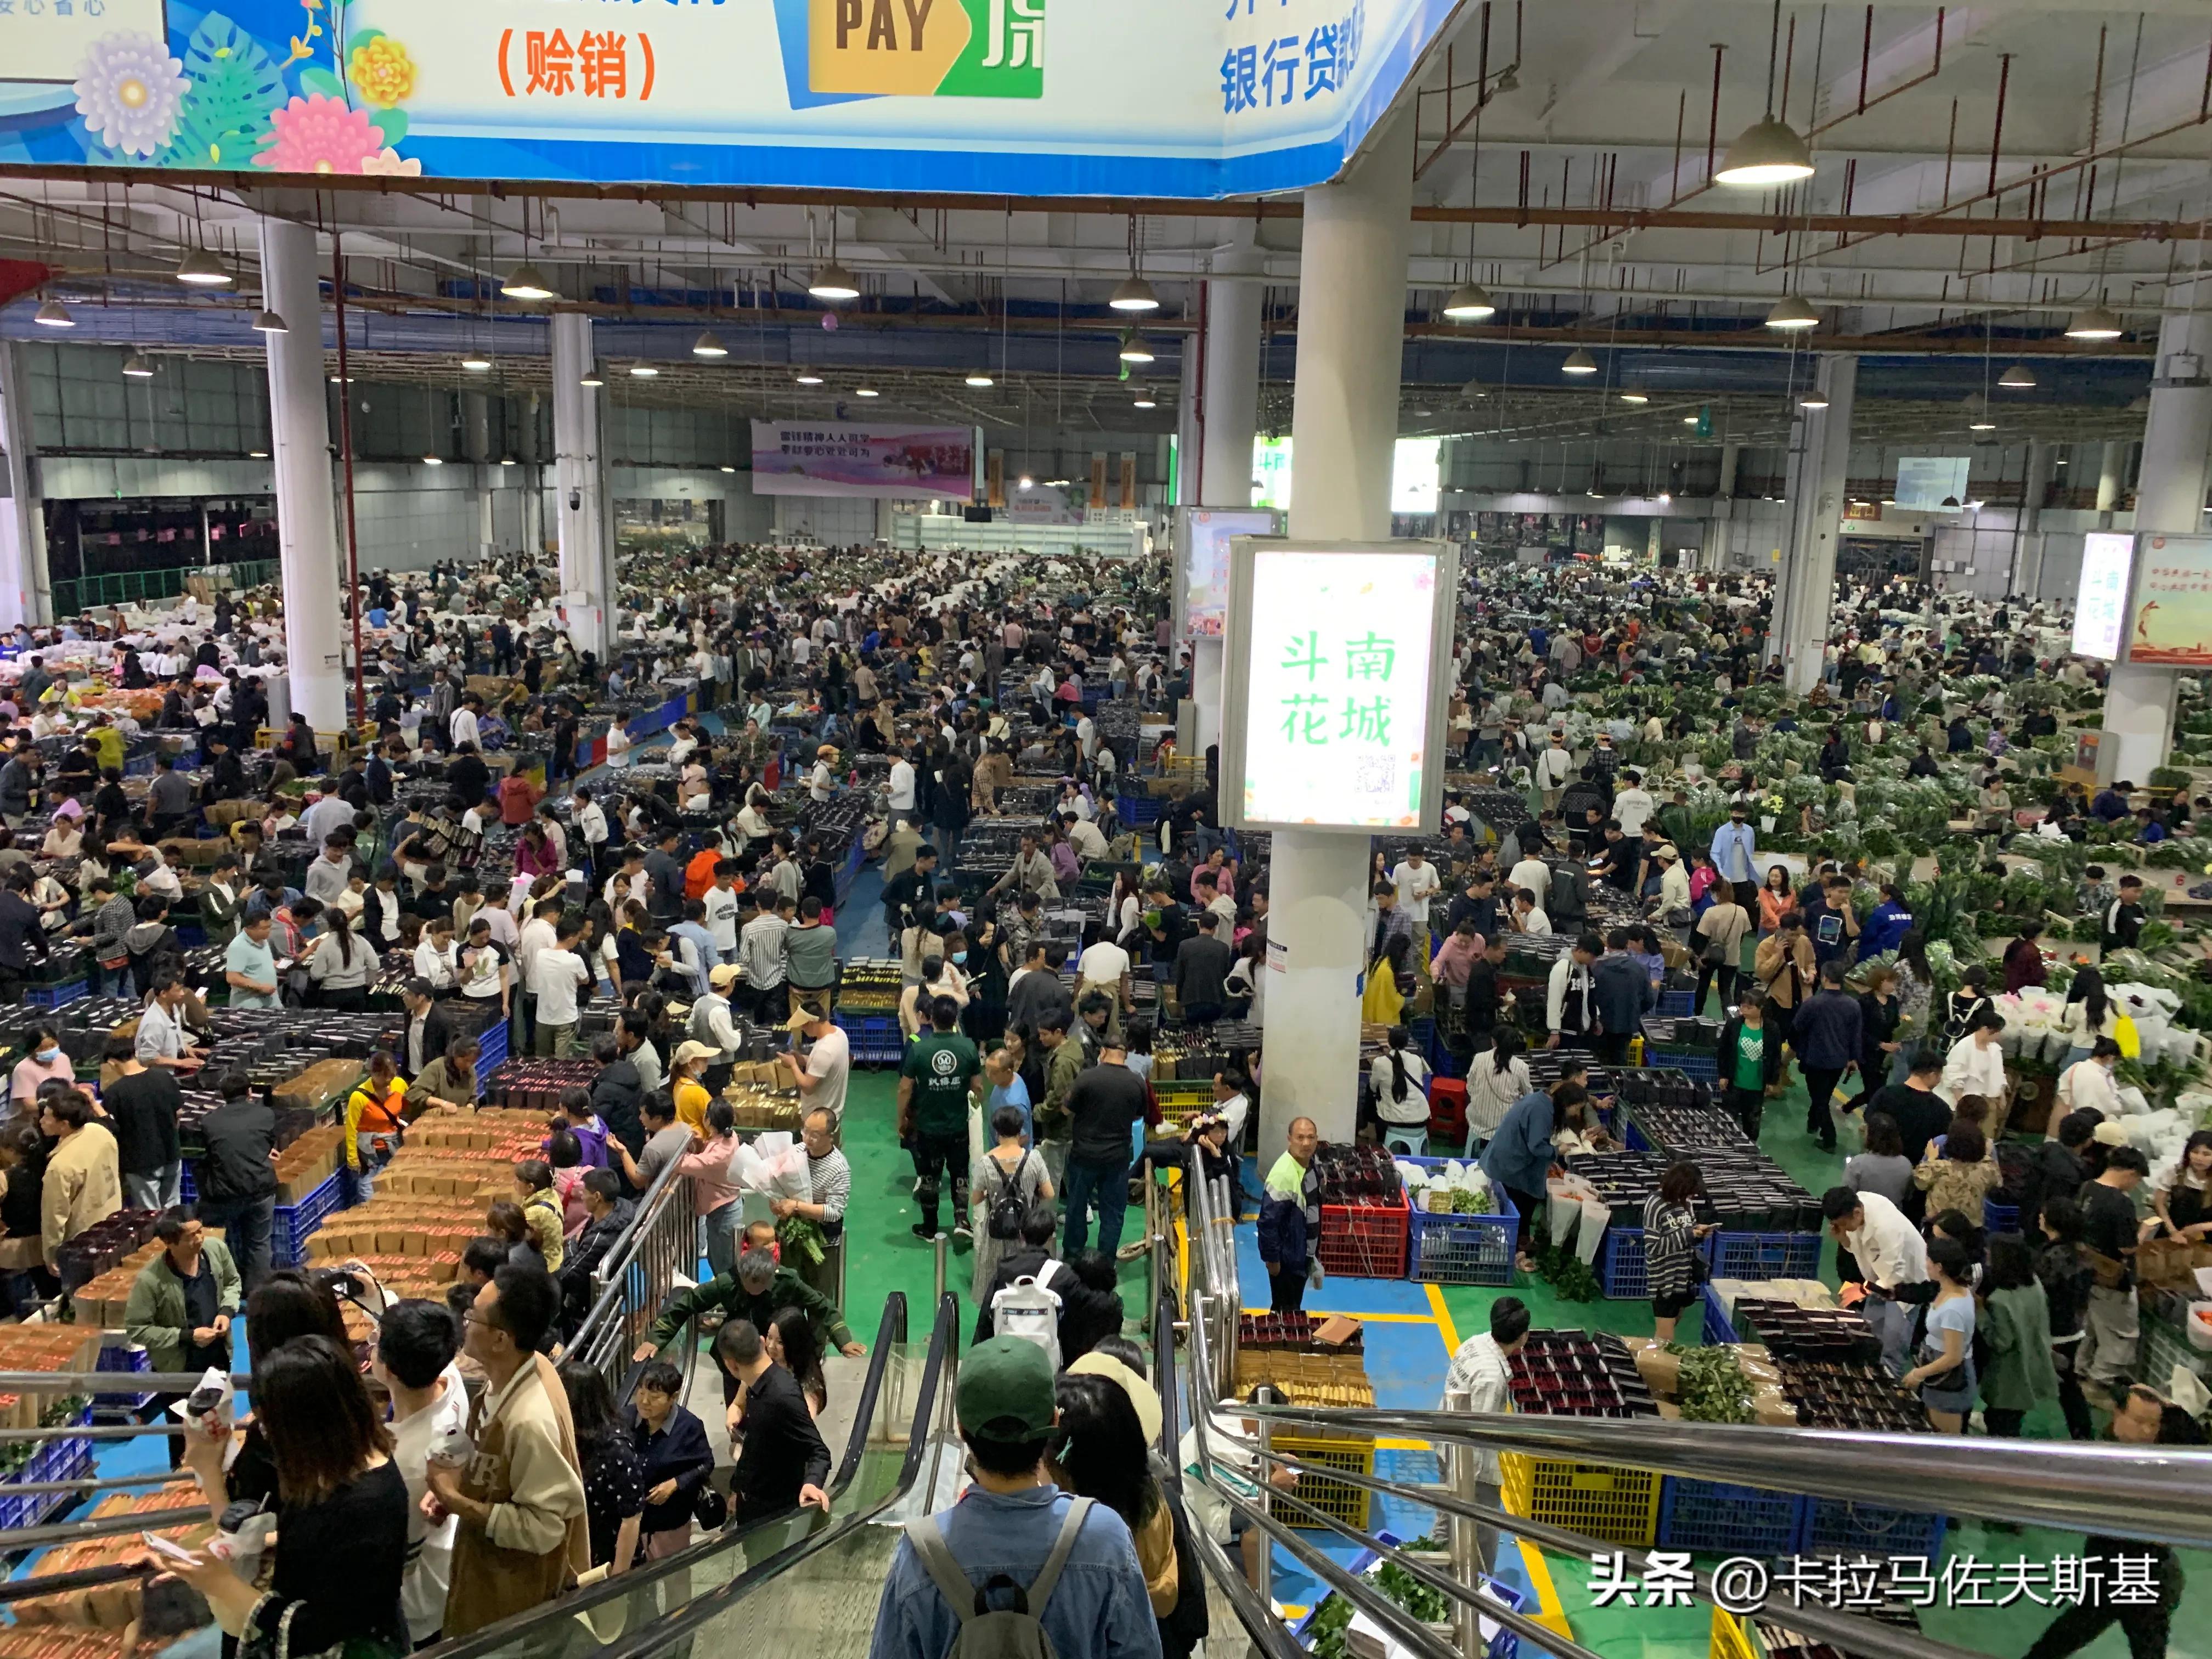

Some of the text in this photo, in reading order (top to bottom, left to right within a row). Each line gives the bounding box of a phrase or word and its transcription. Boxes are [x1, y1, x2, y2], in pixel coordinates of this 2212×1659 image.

[836, 0, 933, 51] PAY
[498, 28, 654, 100] （赊销）
[1281, 631, 1396, 682] 斗南
[1280, 693, 1391, 747] 花城
